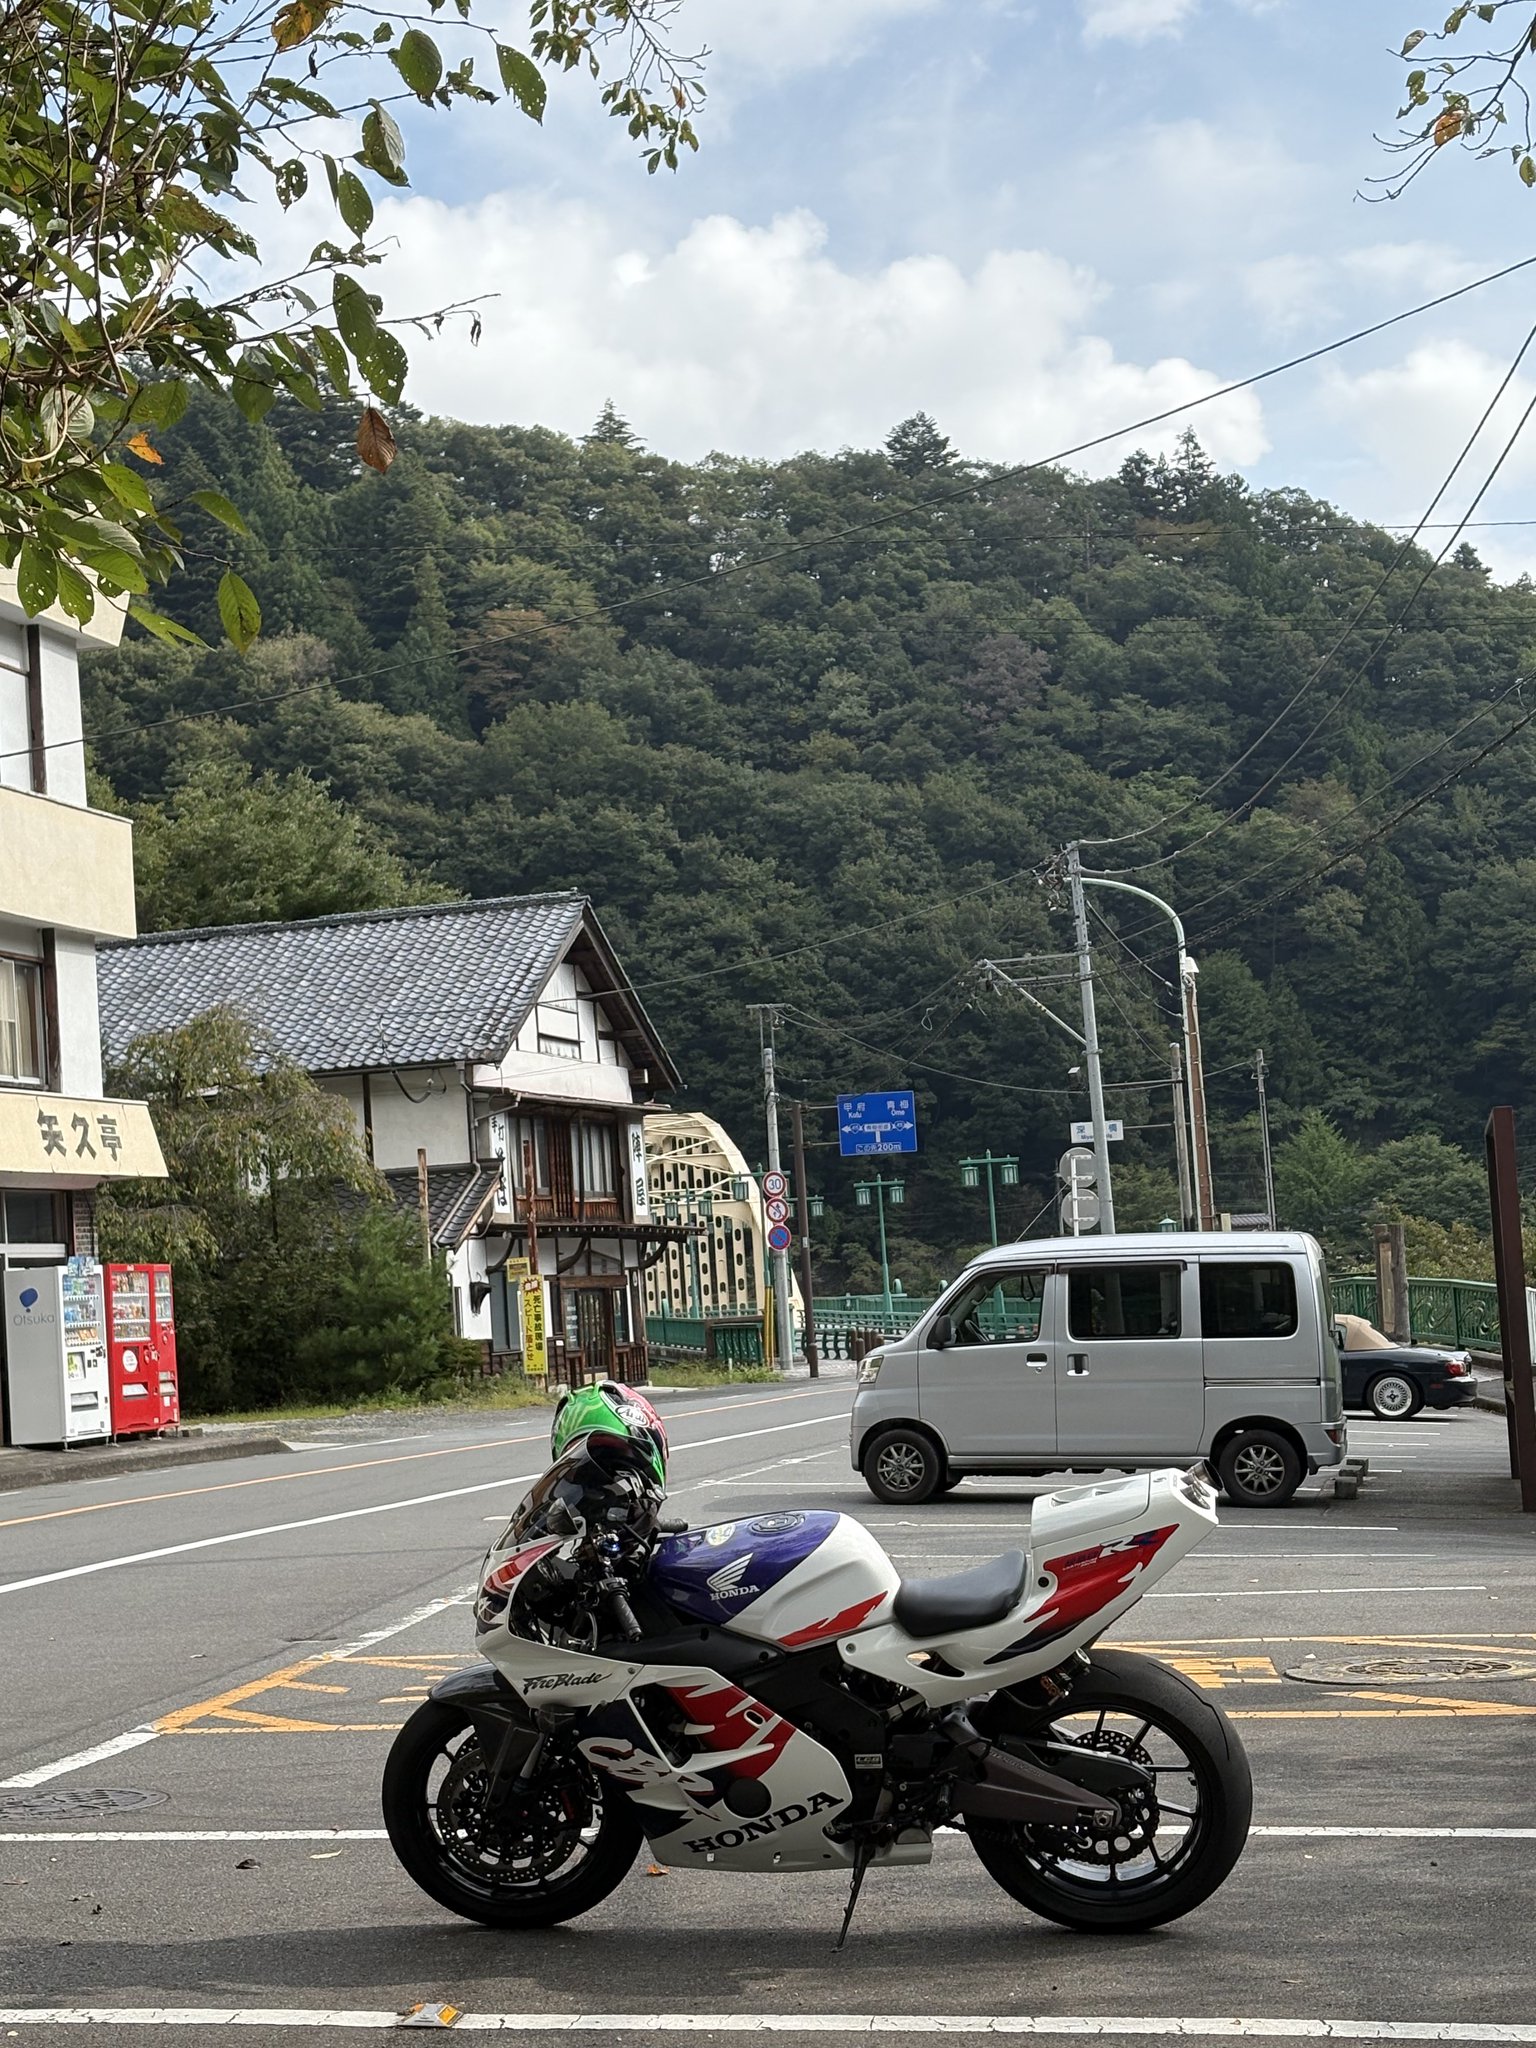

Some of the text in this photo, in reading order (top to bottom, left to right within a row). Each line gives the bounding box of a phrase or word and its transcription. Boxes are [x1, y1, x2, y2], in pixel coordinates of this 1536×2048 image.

[37, 1108, 122, 1162] 矢久亭
[1076, 1123, 1118, 1135] 深橋
[768, 1178, 781, 1190] 30
[13, 1312, 55, 1326] Otsuka
[524, 1299, 534, 1361] スピード落とせ
[533, 1295, 543, 1351] 死亡事故現場
[710, 1585, 760, 1601] HONDA
[523, 1672, 613, 1695] FireBlade
[683, 1791, 845, 1853] HONDA
